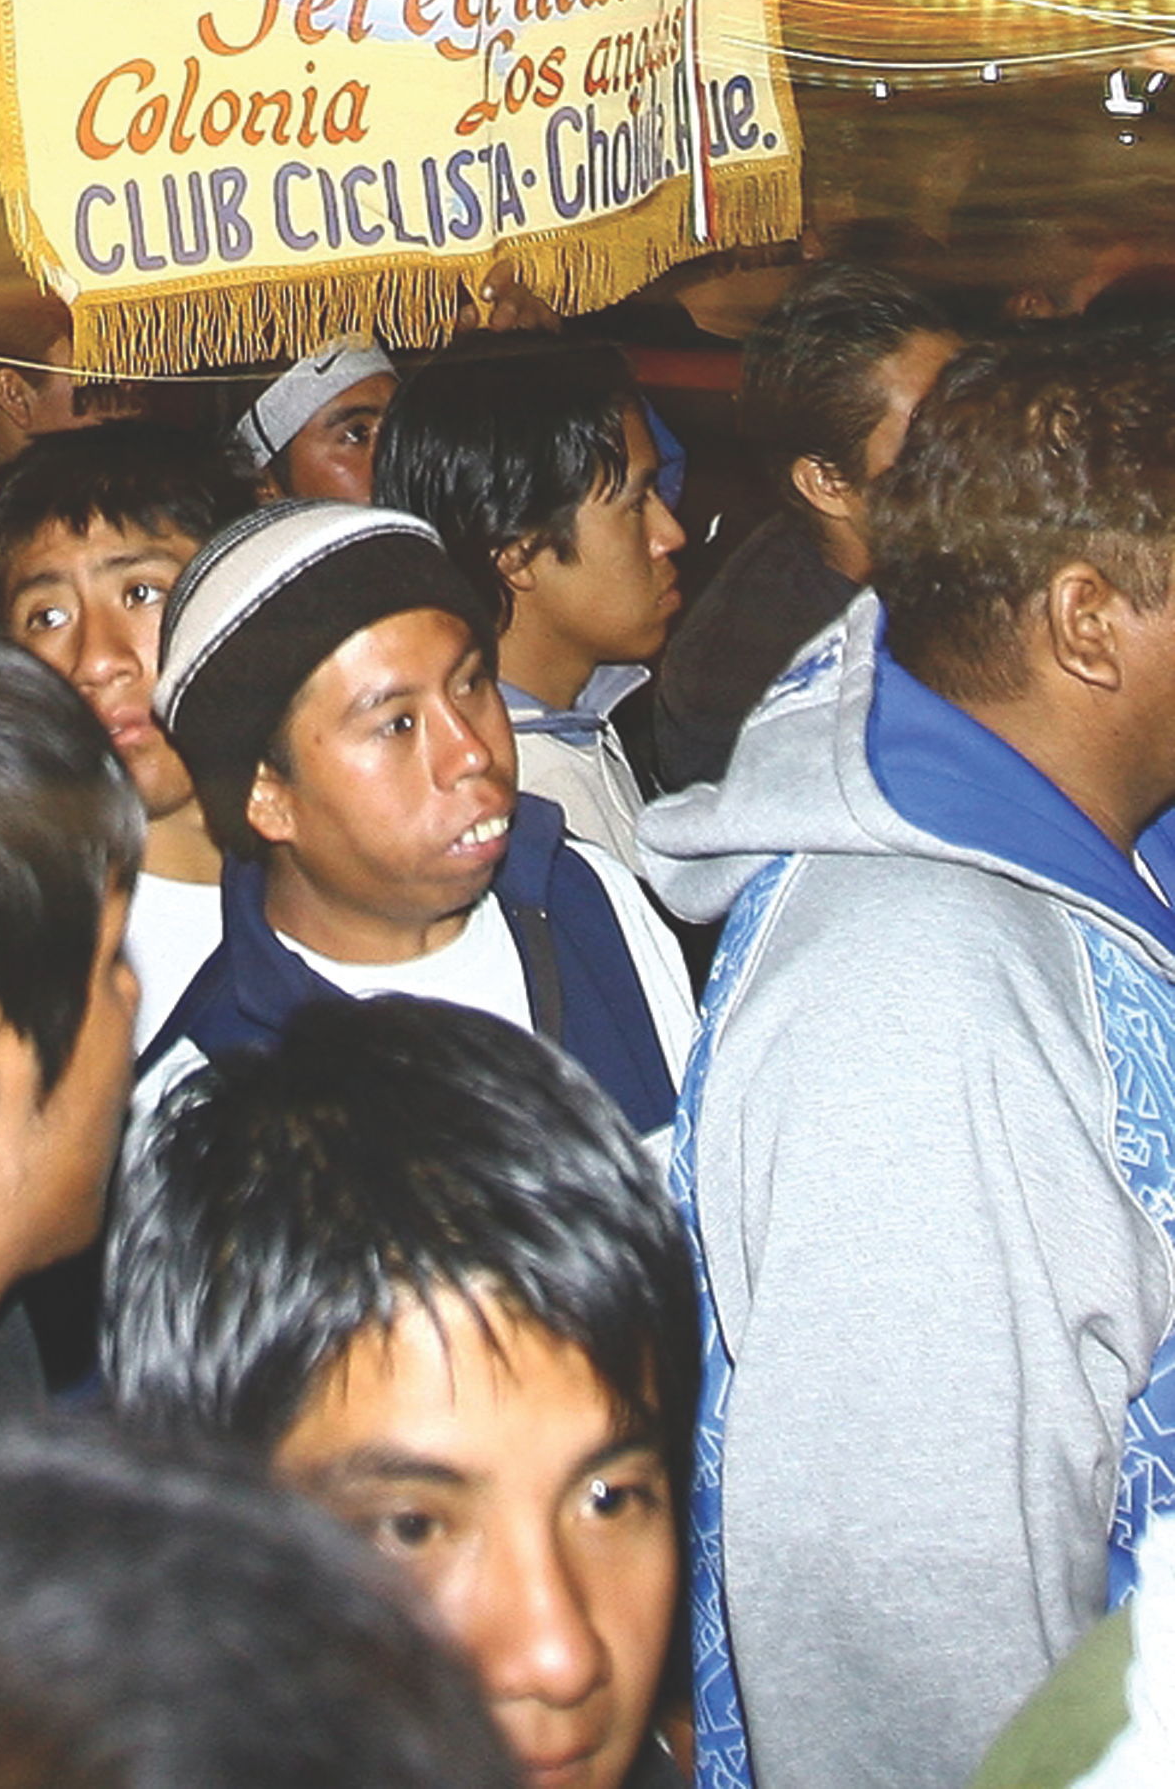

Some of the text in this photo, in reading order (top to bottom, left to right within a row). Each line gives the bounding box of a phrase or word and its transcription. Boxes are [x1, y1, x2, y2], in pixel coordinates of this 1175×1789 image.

[75, 56, 371, 161] Colonia
[456, 29, 567, 136] Los
[75, 166, 253, 275] CLUB
